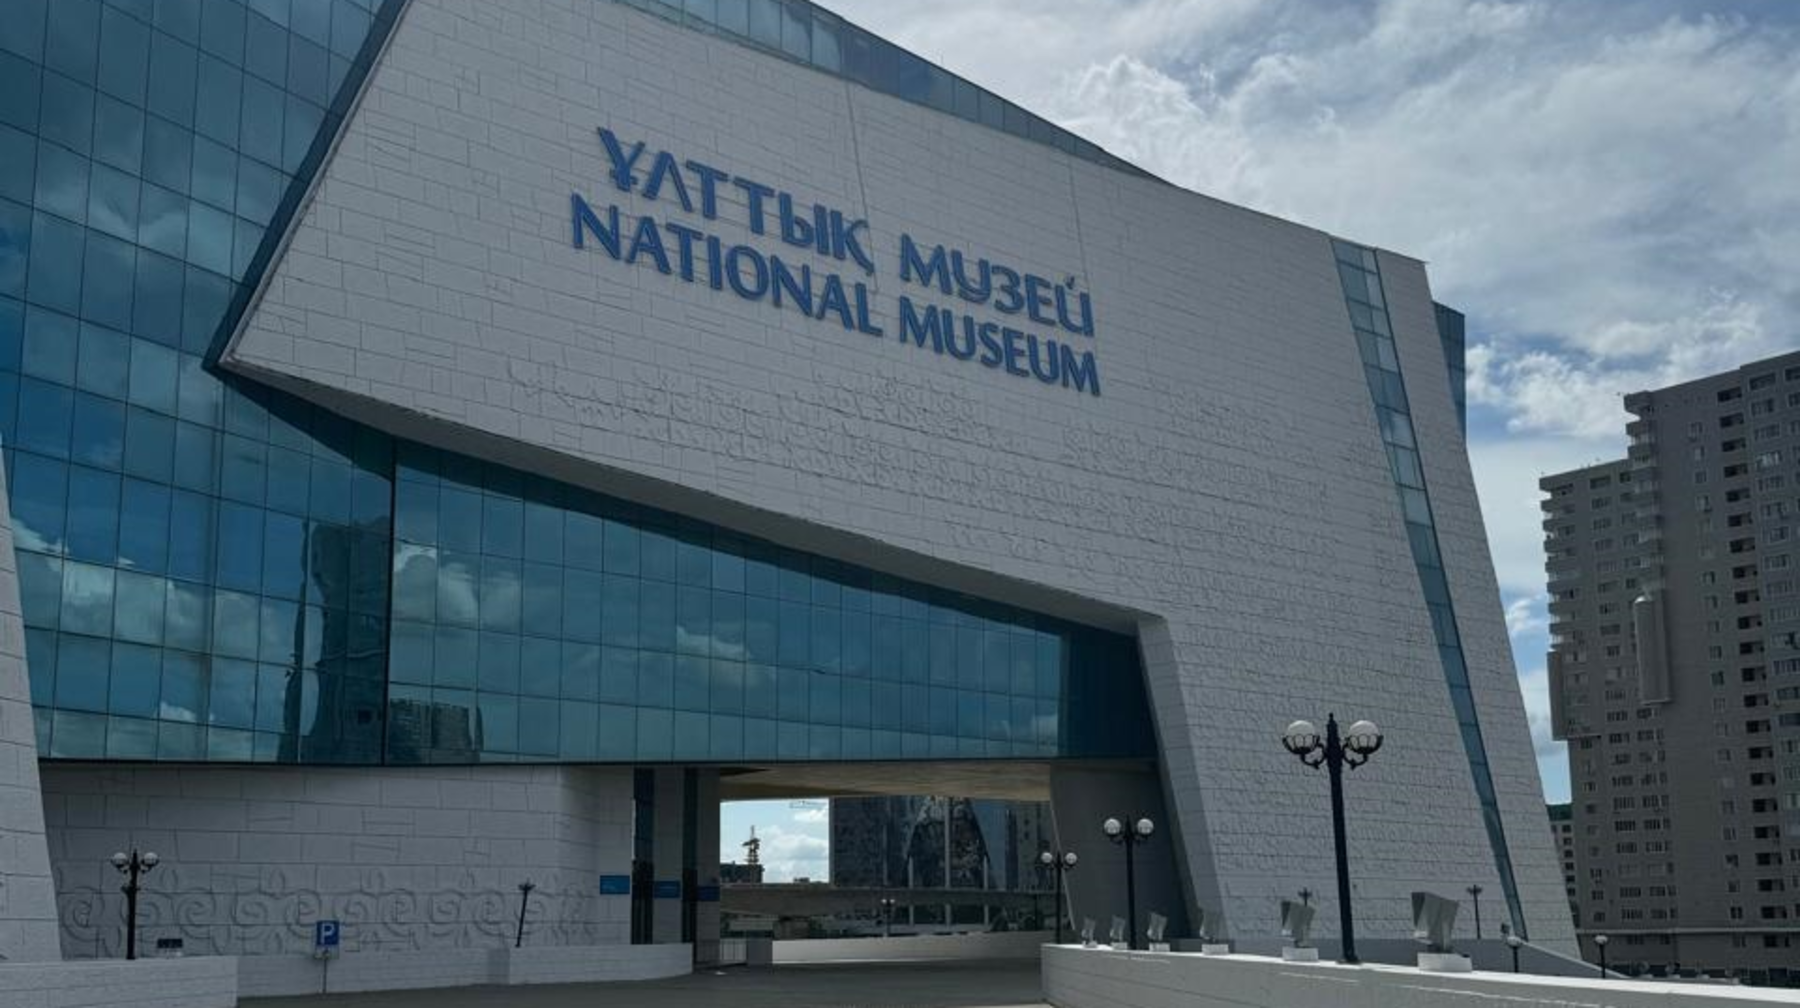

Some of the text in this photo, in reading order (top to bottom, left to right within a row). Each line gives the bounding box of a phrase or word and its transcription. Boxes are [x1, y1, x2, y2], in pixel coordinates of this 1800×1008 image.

[570, 192, 1100, 396] NATIONAL MUSEUM
[597, 126, 1095, 337] ҰЛТТЫҚ МУЗЕЙ
[321, 923, 335, 945] P
